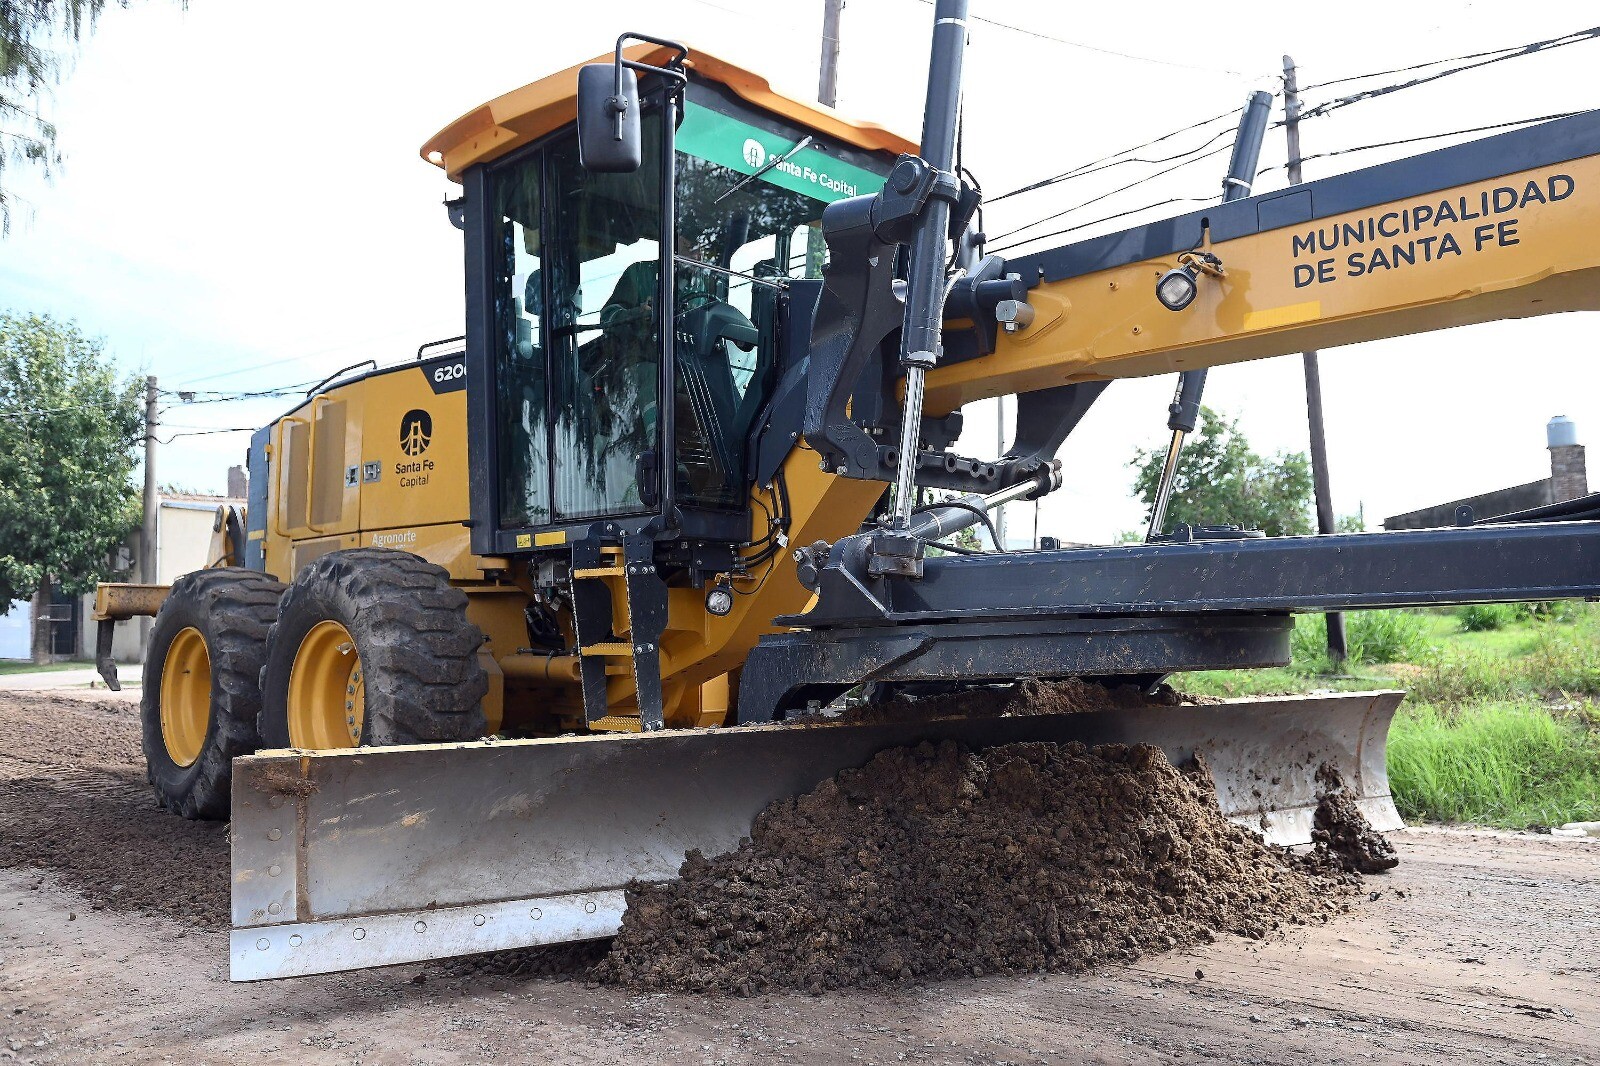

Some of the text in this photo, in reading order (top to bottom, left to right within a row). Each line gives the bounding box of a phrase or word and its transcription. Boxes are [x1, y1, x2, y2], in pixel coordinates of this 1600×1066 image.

[803, 166, 818, 183] Fe
[819, 173, 857, 197] Capital
[1292, 174, 1576, 258] MUNICIPALIDAD
[1293, 219, 1520, 288] DE SANTA FE
[434, 363, 467, 383] 620
[395, 459, 434, 474] Santa Fe
[399, 474, 429, 488] Capital
[371, 530, 417, 547] Agronorte
